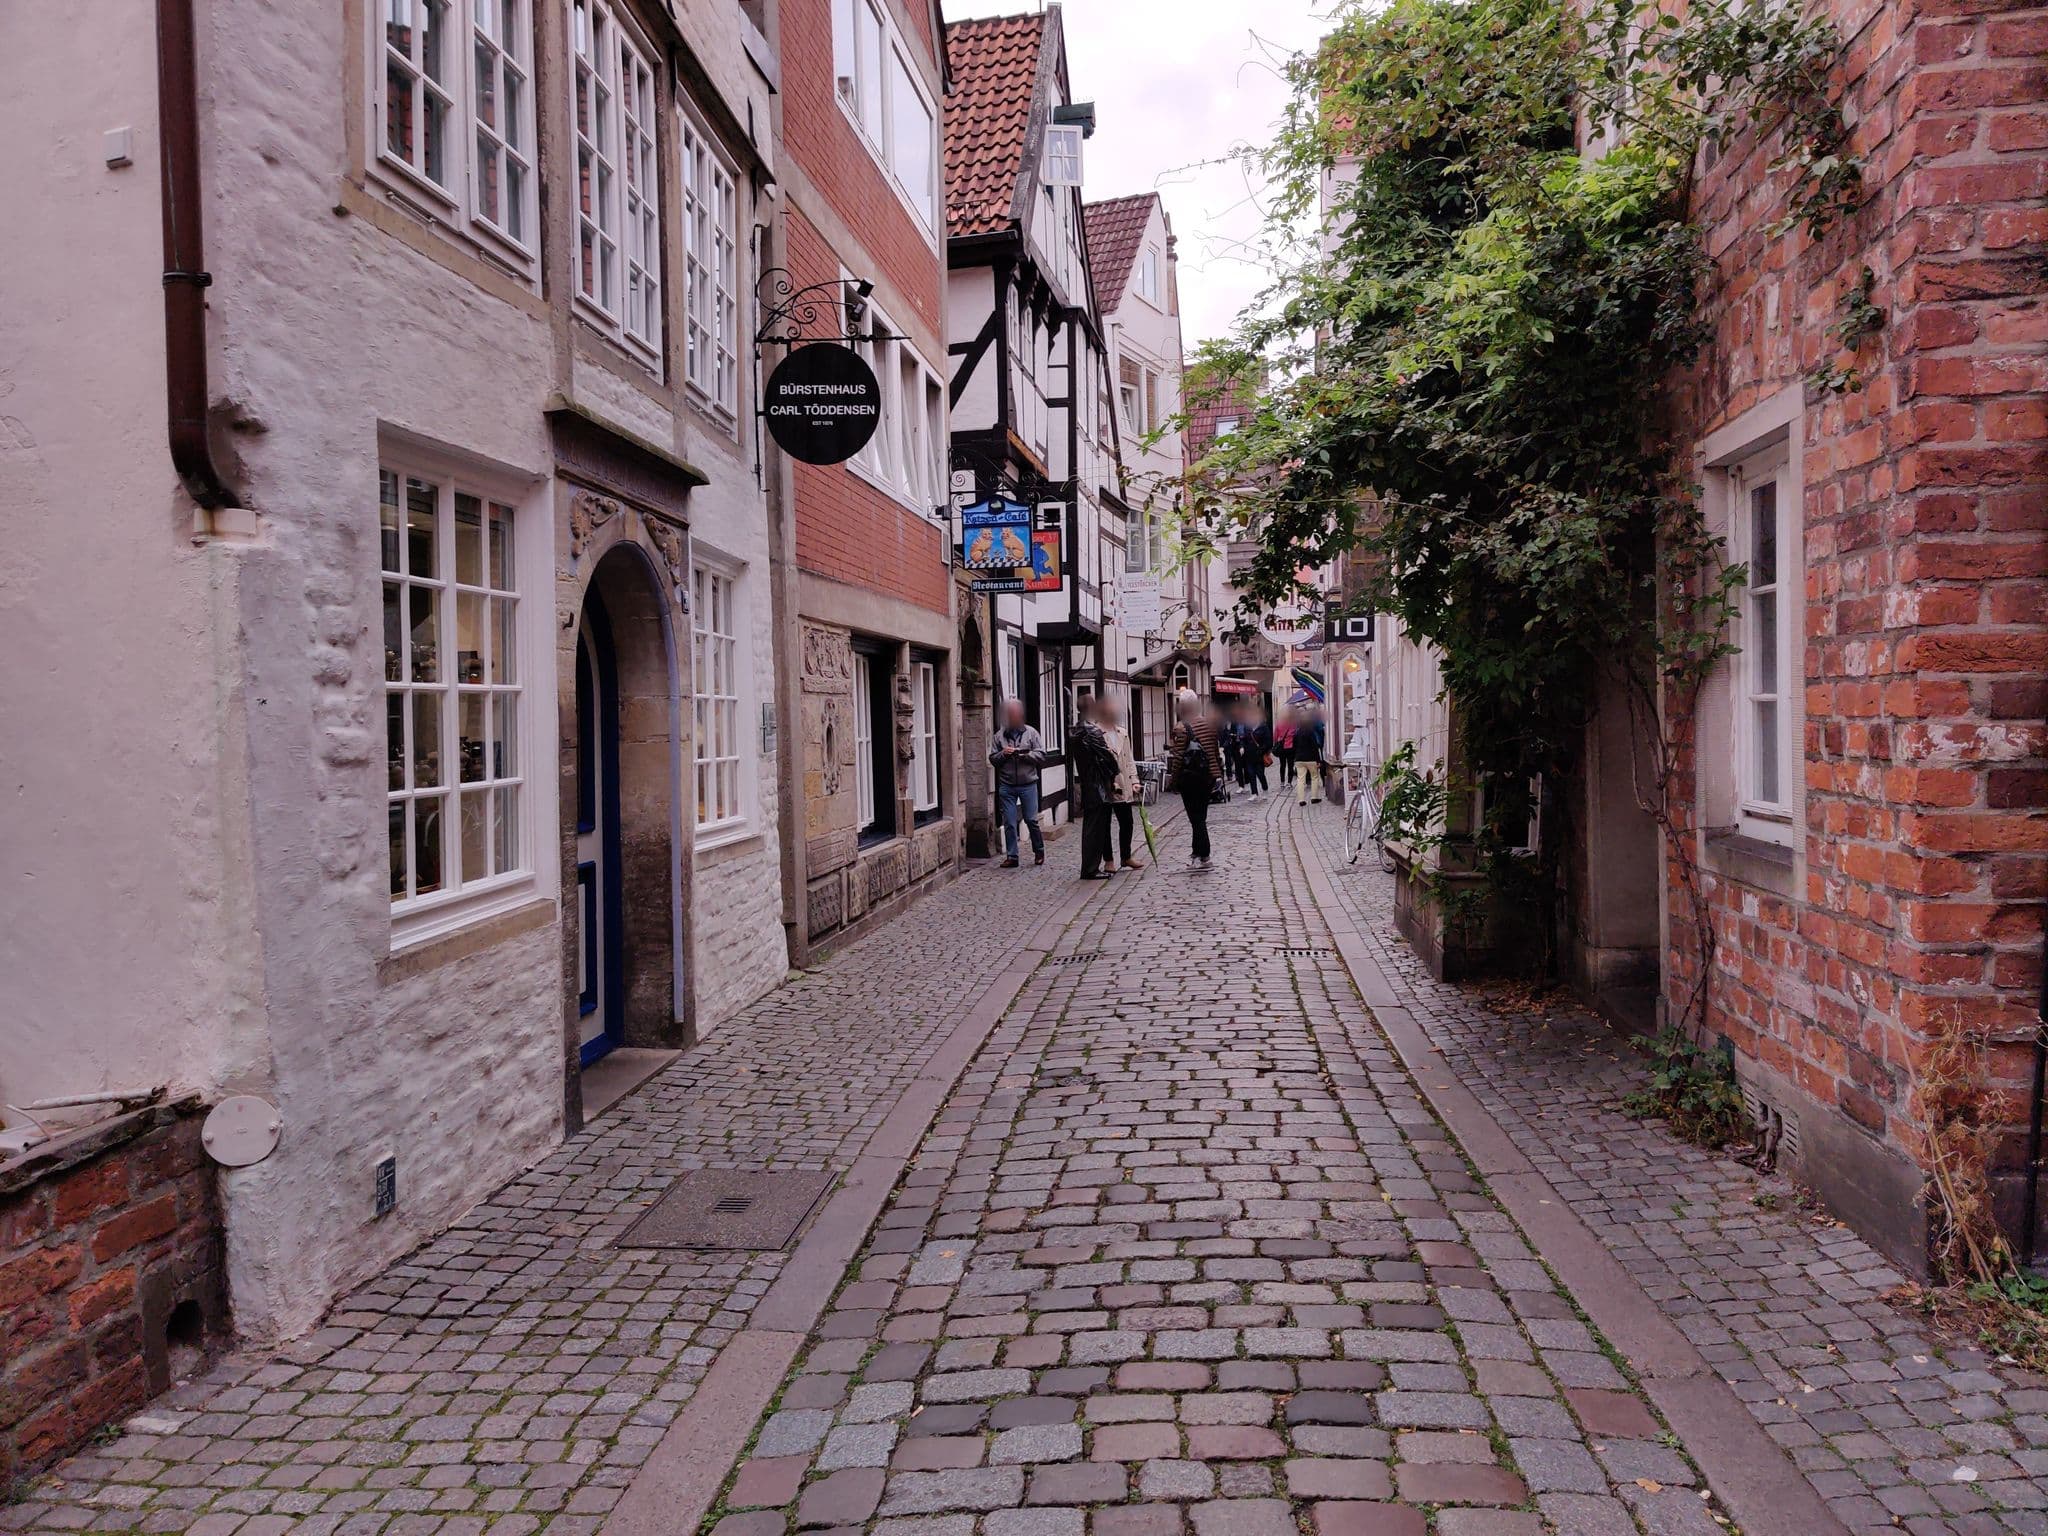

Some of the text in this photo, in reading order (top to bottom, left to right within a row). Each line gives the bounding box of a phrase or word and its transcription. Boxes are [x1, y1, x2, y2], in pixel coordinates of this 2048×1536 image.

[780, 383, 867, 395] BÜRSTENHAUS
[770, 403, 875, 415] CARL TÖDDENSEN
[972, 581, 1024, 590] Restaurant
